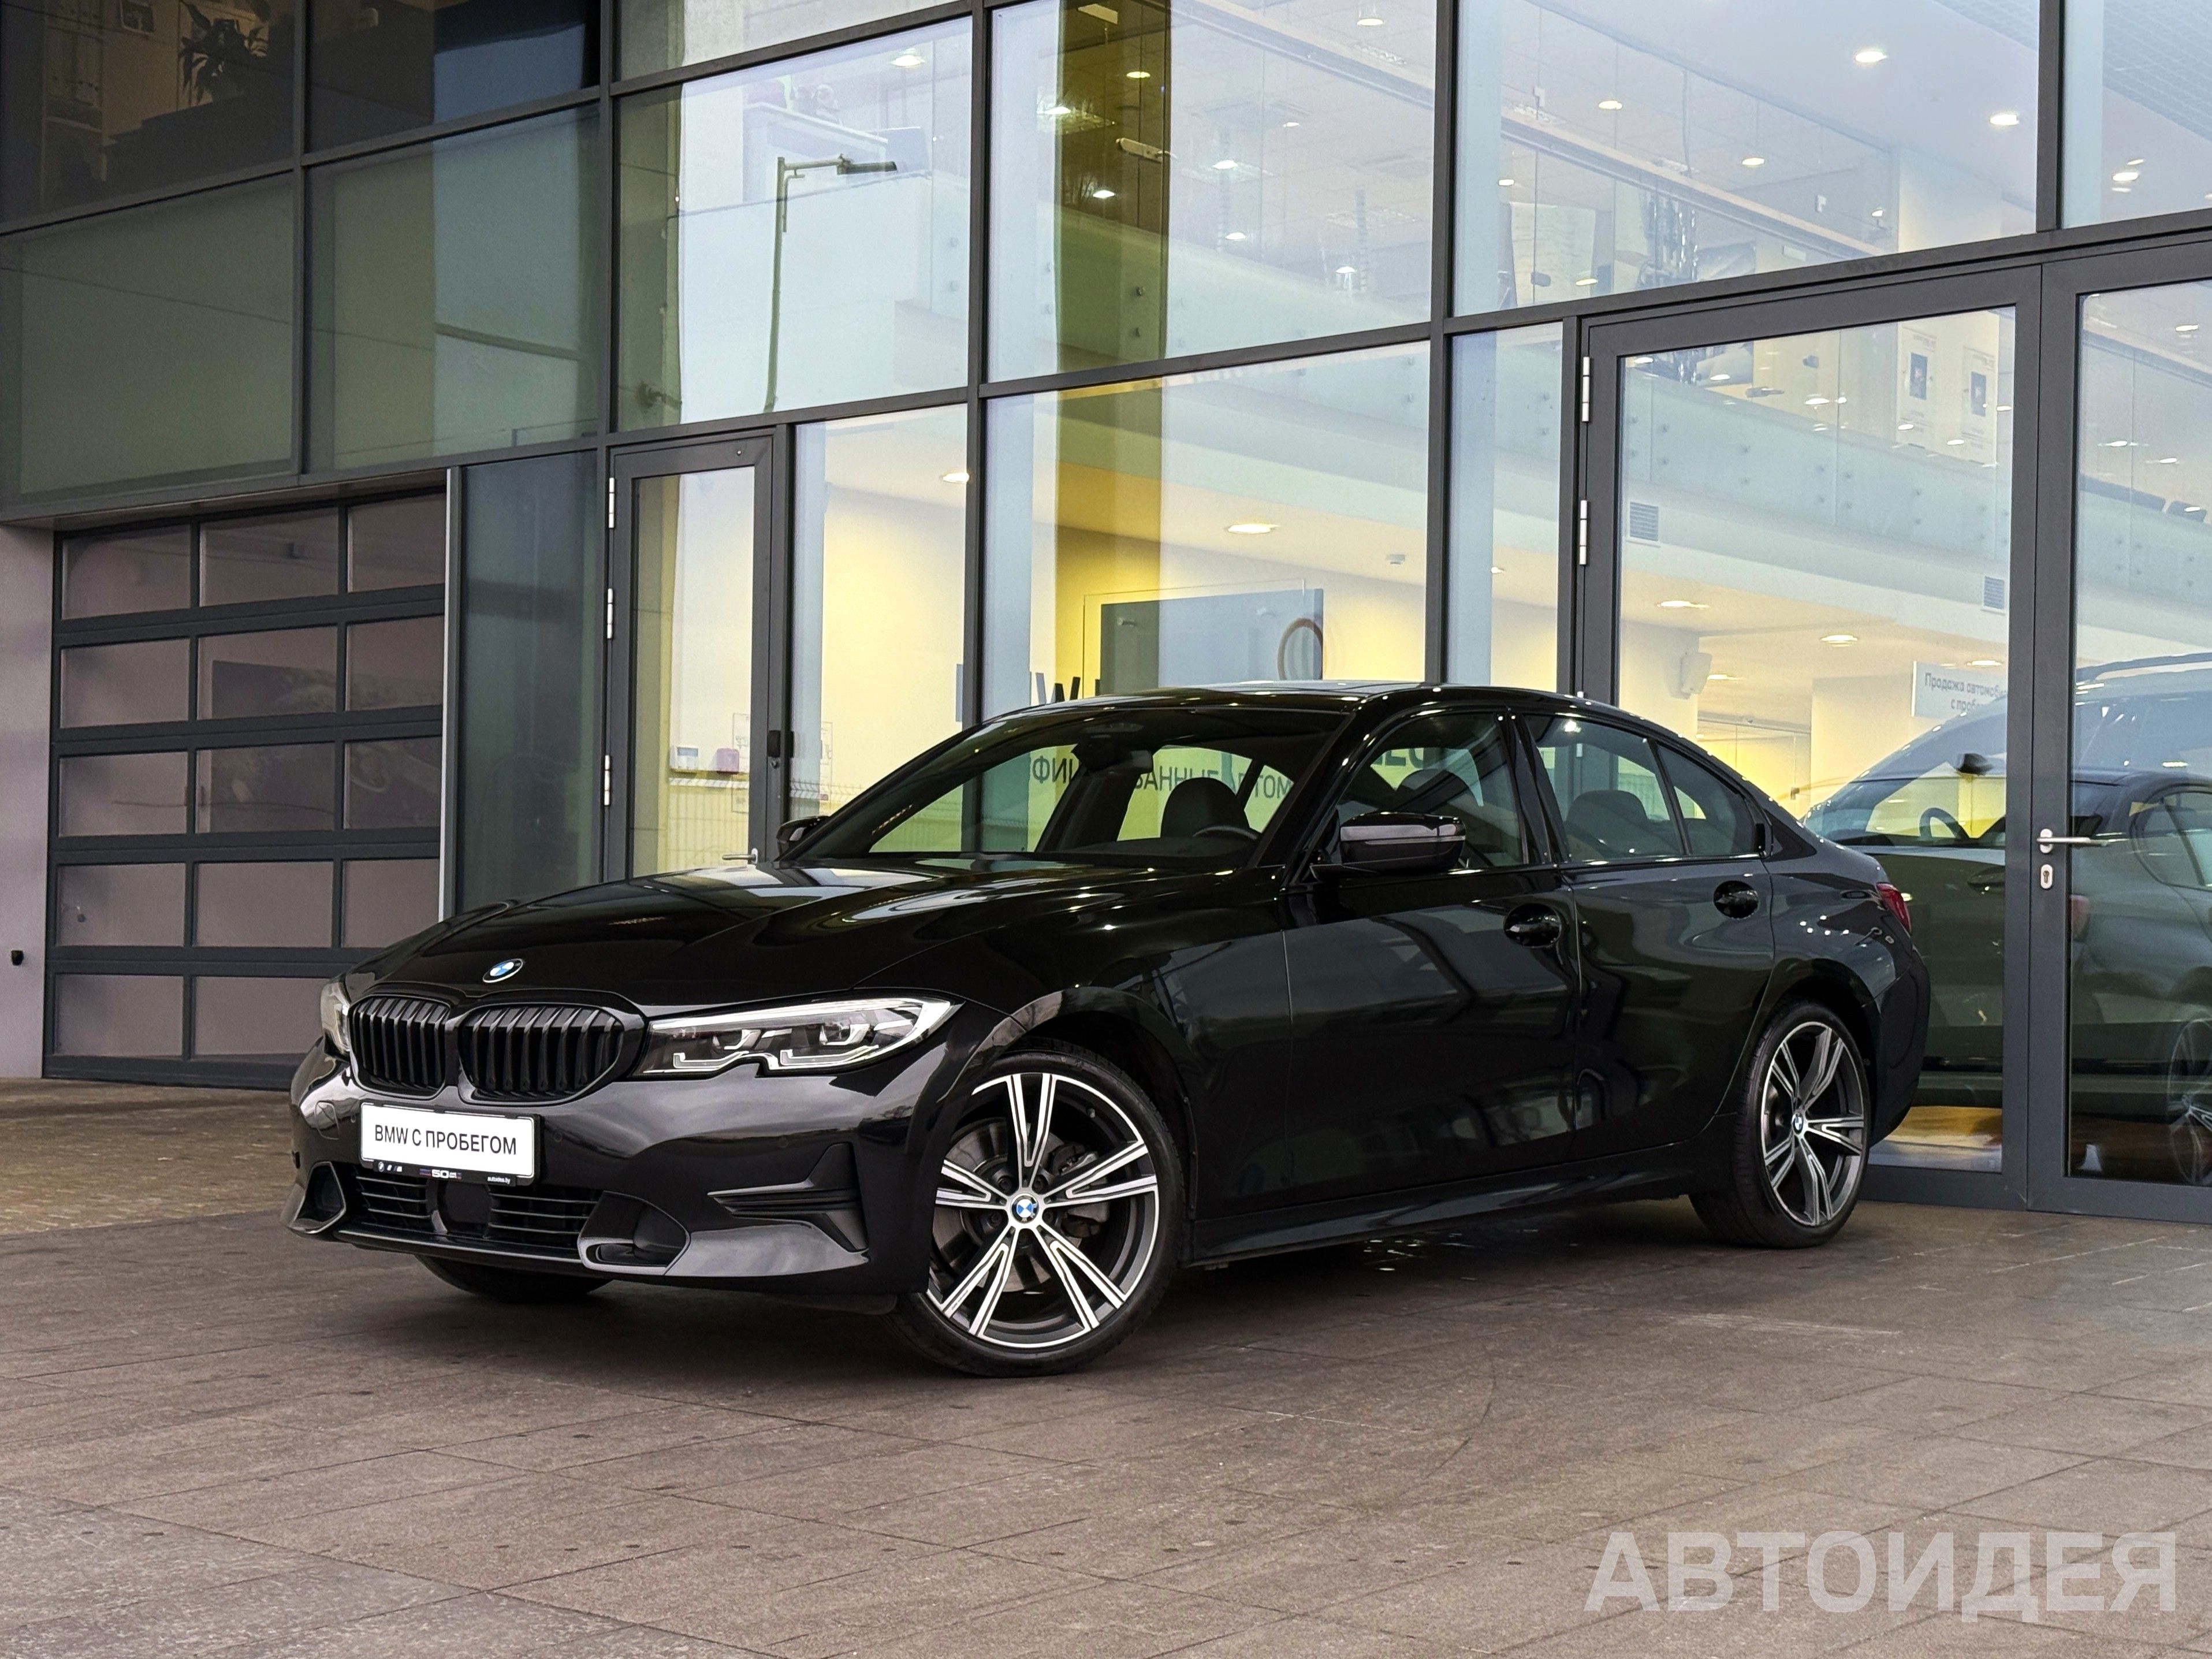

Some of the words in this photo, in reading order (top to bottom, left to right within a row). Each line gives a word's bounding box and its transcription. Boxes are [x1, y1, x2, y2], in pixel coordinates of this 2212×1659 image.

[1925, 672, 1965, 693] Продажа
[375, 1124, 408, 1144] BMW
[412, 1128, 422, 1146] С
[426, 1130, 516, 1155] ПРОБЕГОМ
